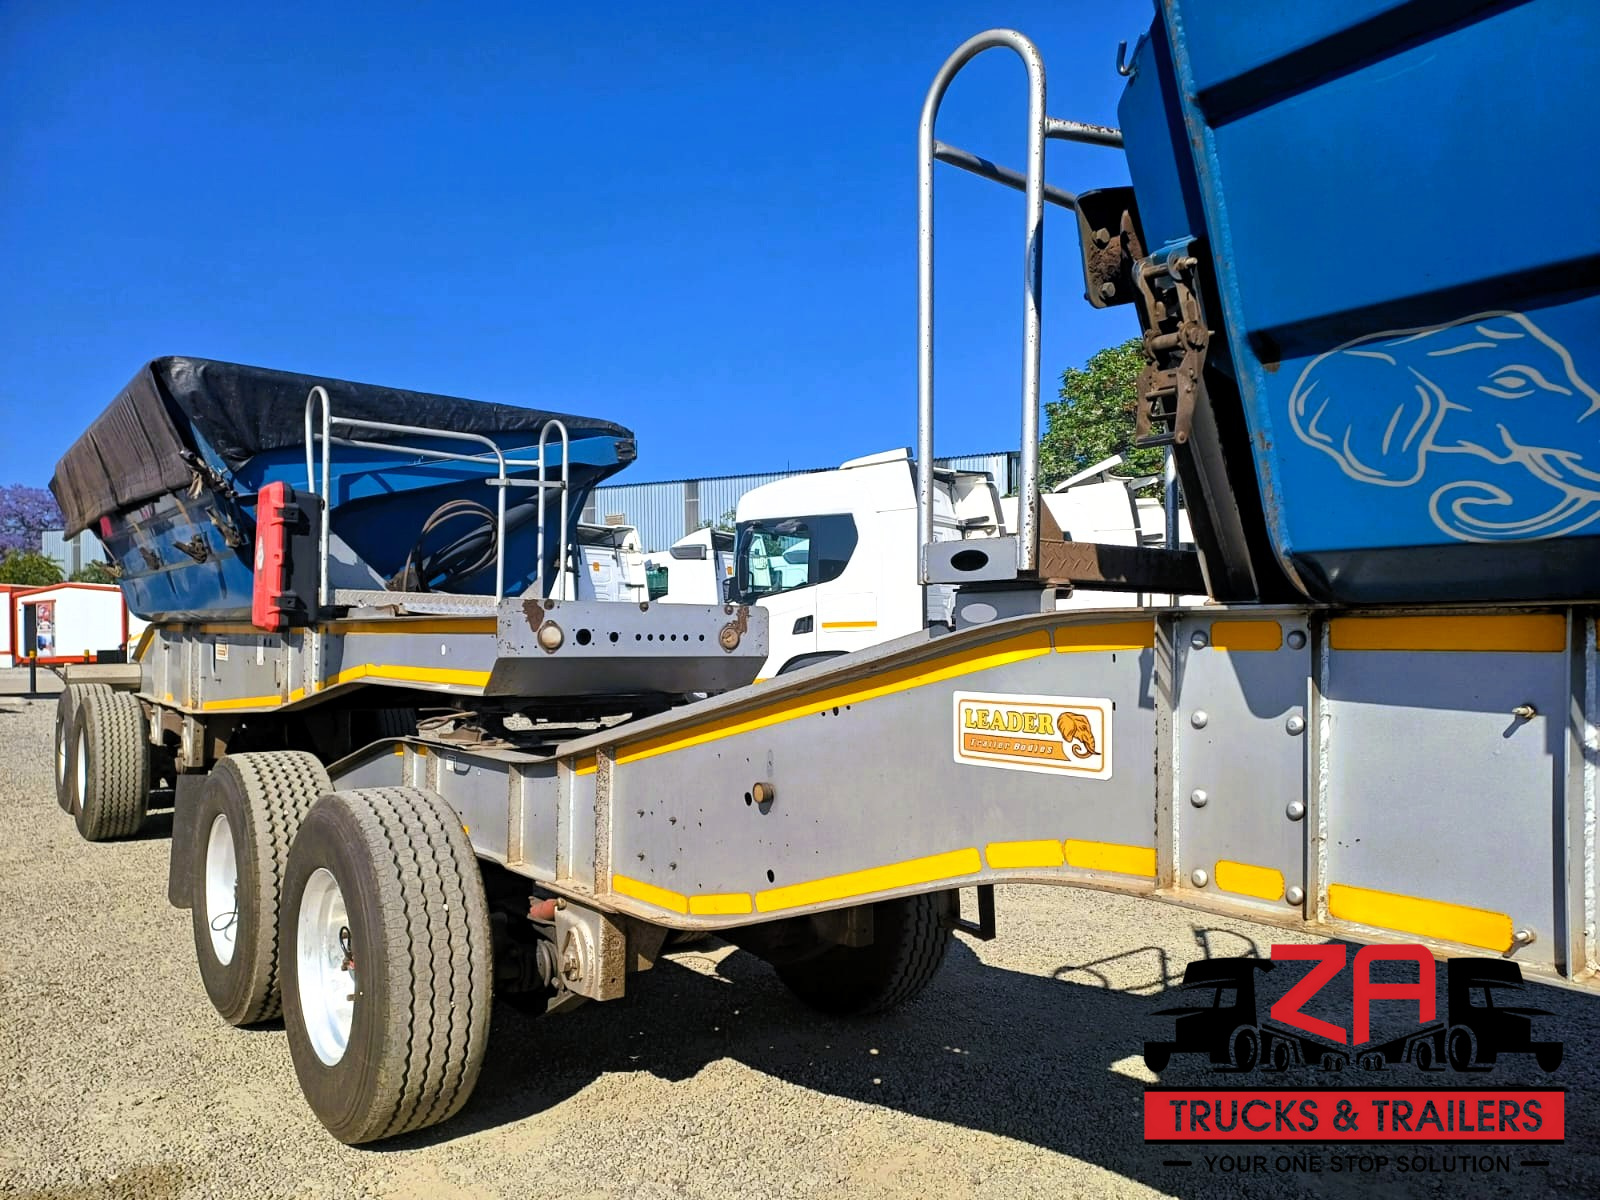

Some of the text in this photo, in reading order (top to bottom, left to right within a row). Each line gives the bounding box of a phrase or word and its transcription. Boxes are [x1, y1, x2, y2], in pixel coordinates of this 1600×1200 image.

[965, 708, 1055, 735] LEADER
[970, 738, 1054, 754] Trailer Bodies
